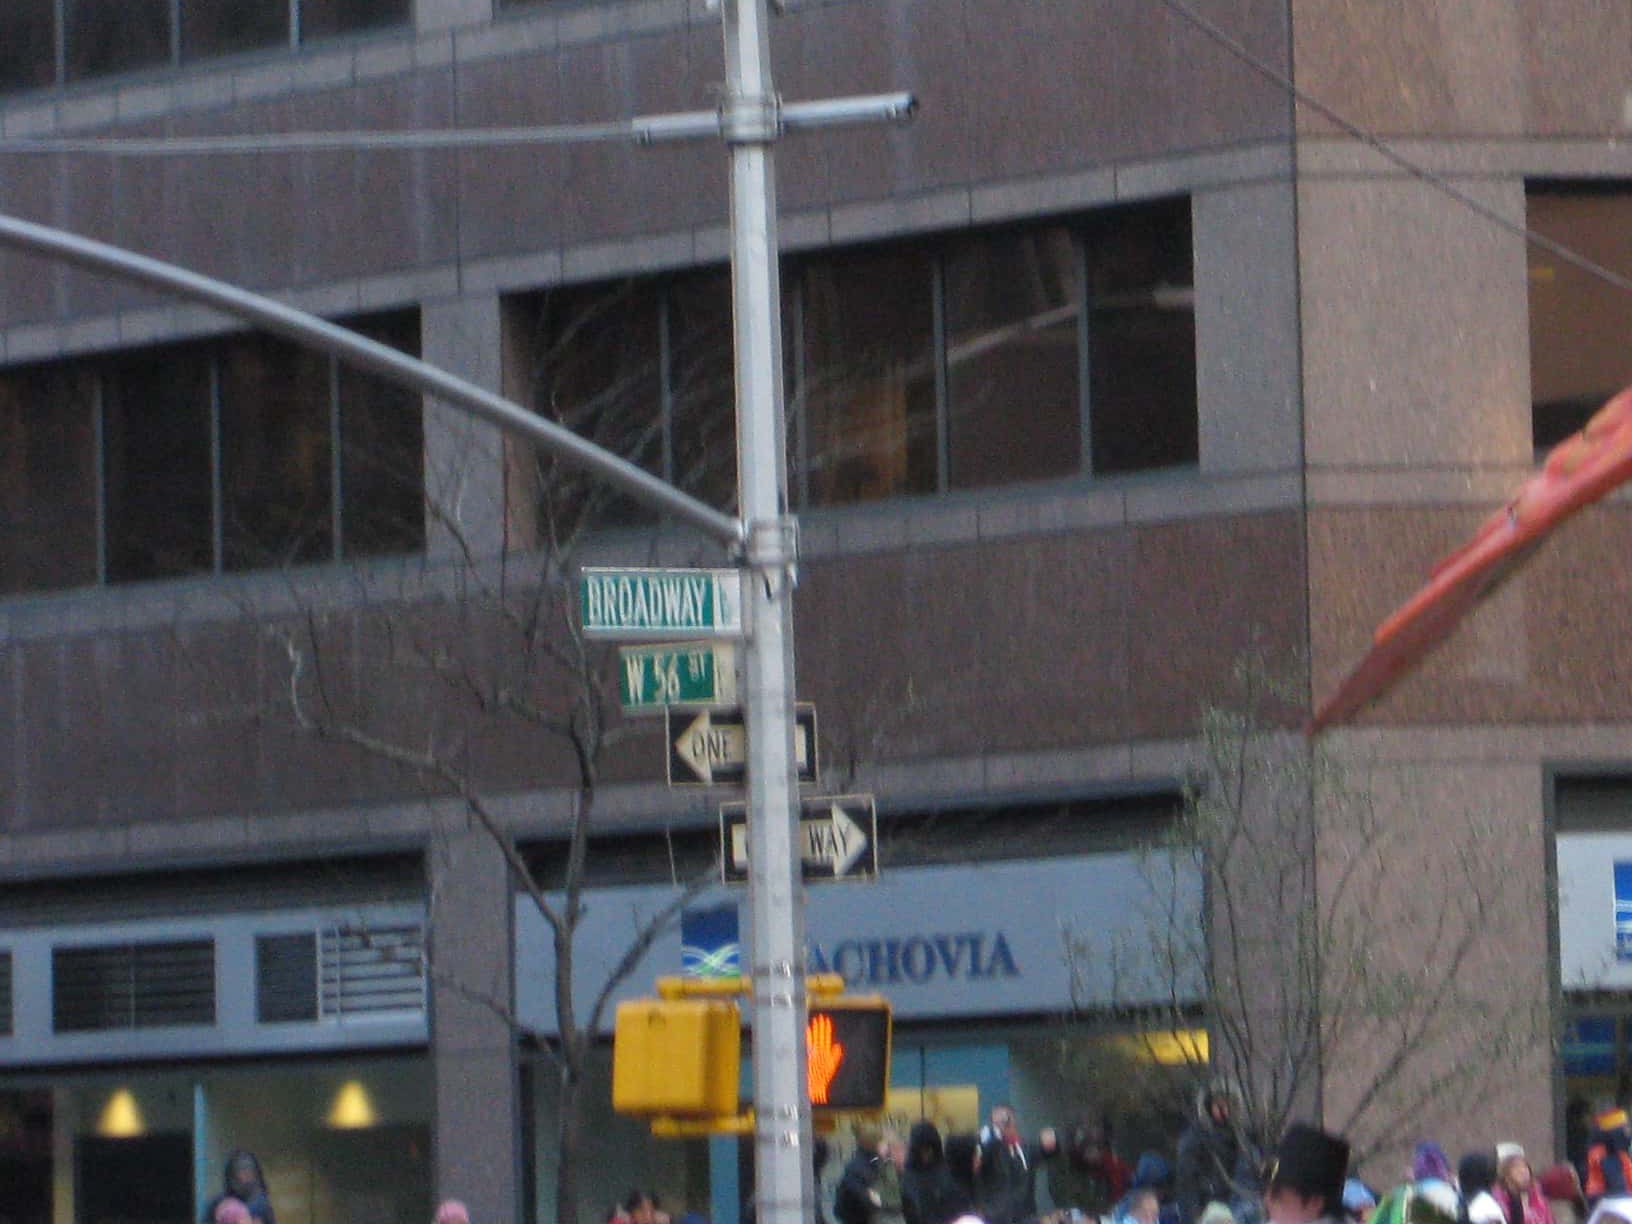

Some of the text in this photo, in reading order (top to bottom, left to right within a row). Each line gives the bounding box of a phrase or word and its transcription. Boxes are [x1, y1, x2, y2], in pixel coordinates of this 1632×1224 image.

[587, 575, 706, 626] BROADWAY
[625, 655, 645, 704] W
[653, 652, 680, 704] 56
[691, 725, 729, 763] ONE
[807, 823, 851, 859] WAY
[802, 929, 1023, 985] ACHOVIA
